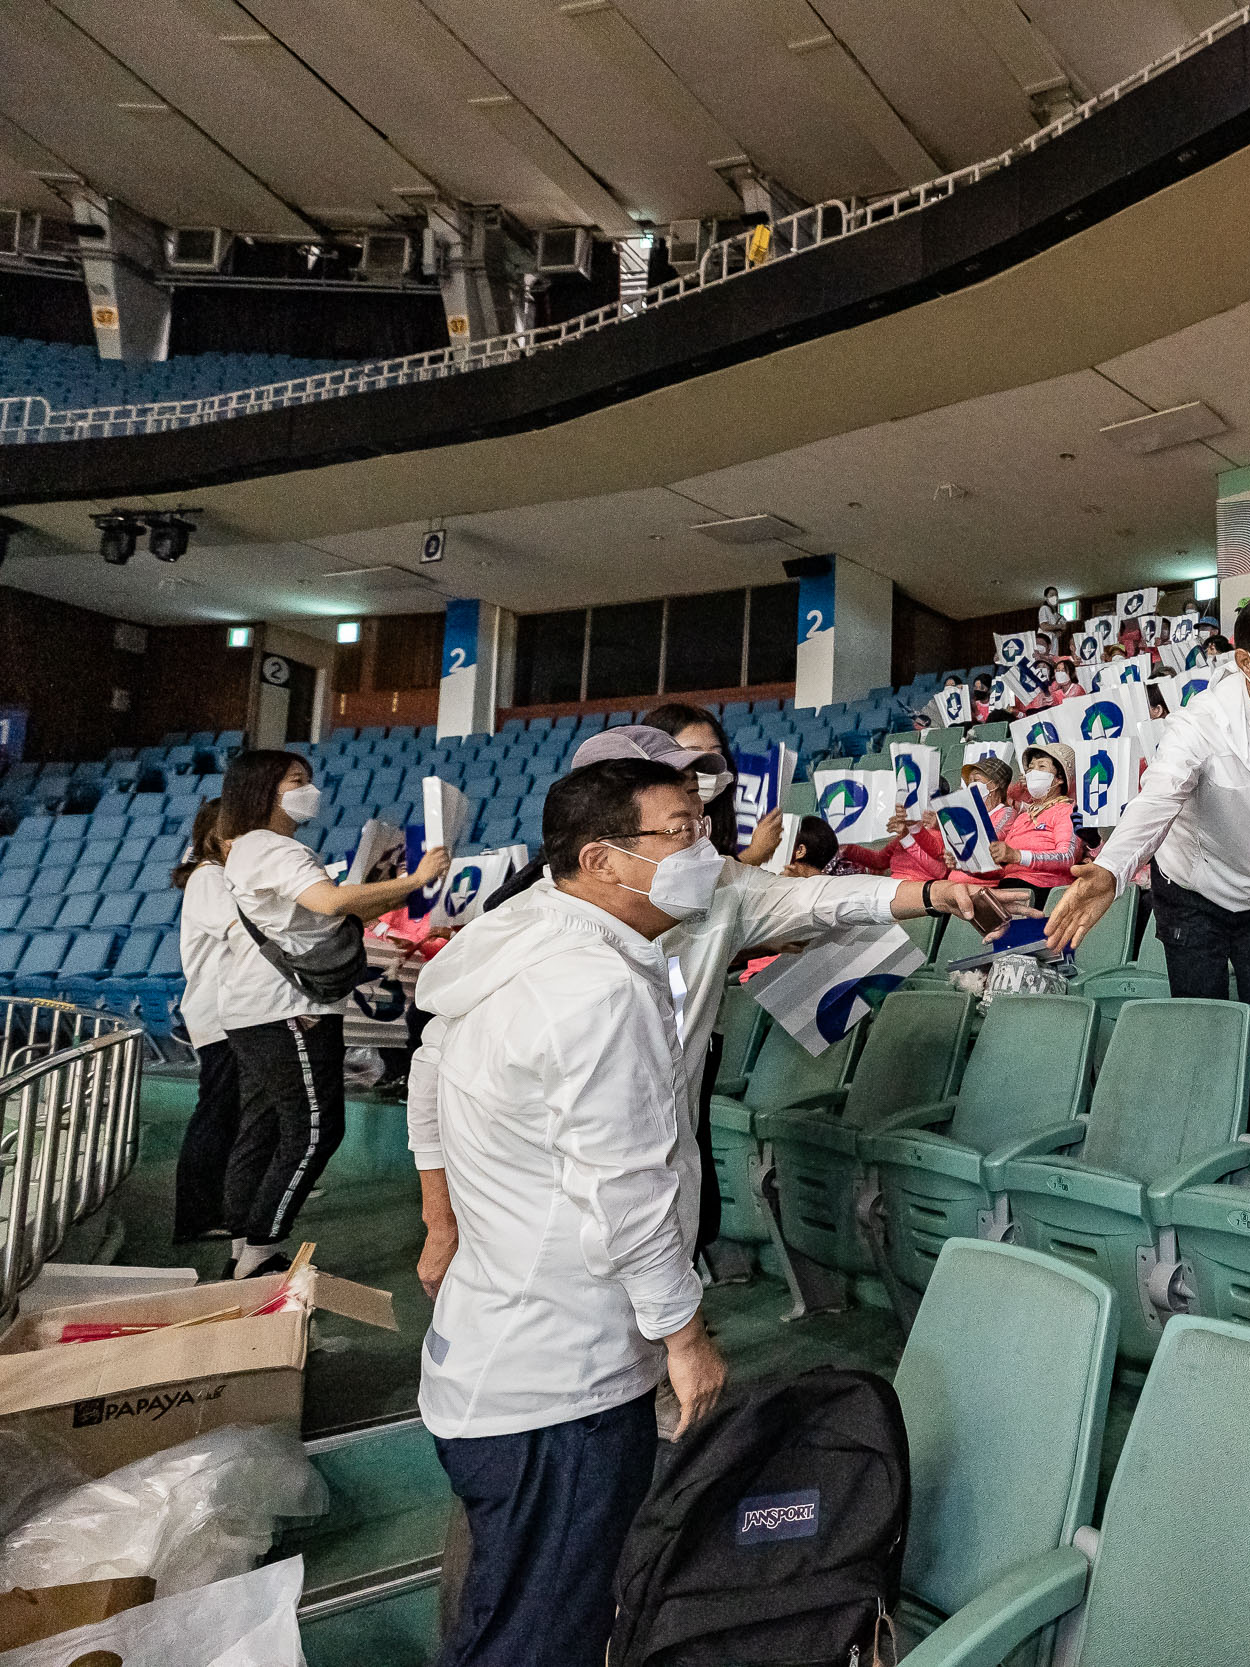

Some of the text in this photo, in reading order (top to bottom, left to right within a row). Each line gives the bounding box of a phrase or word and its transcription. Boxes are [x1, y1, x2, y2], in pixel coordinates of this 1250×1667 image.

[451, 318, 465, 333] 37
[807, 609, 823, 638] 2
[270, 660, 283, 679] 2
[449, 647, 466, 673] 2
[105, 1390, 195, 1421] PAPAYA
[742, 1503, 815, 1532] JANSPORT
